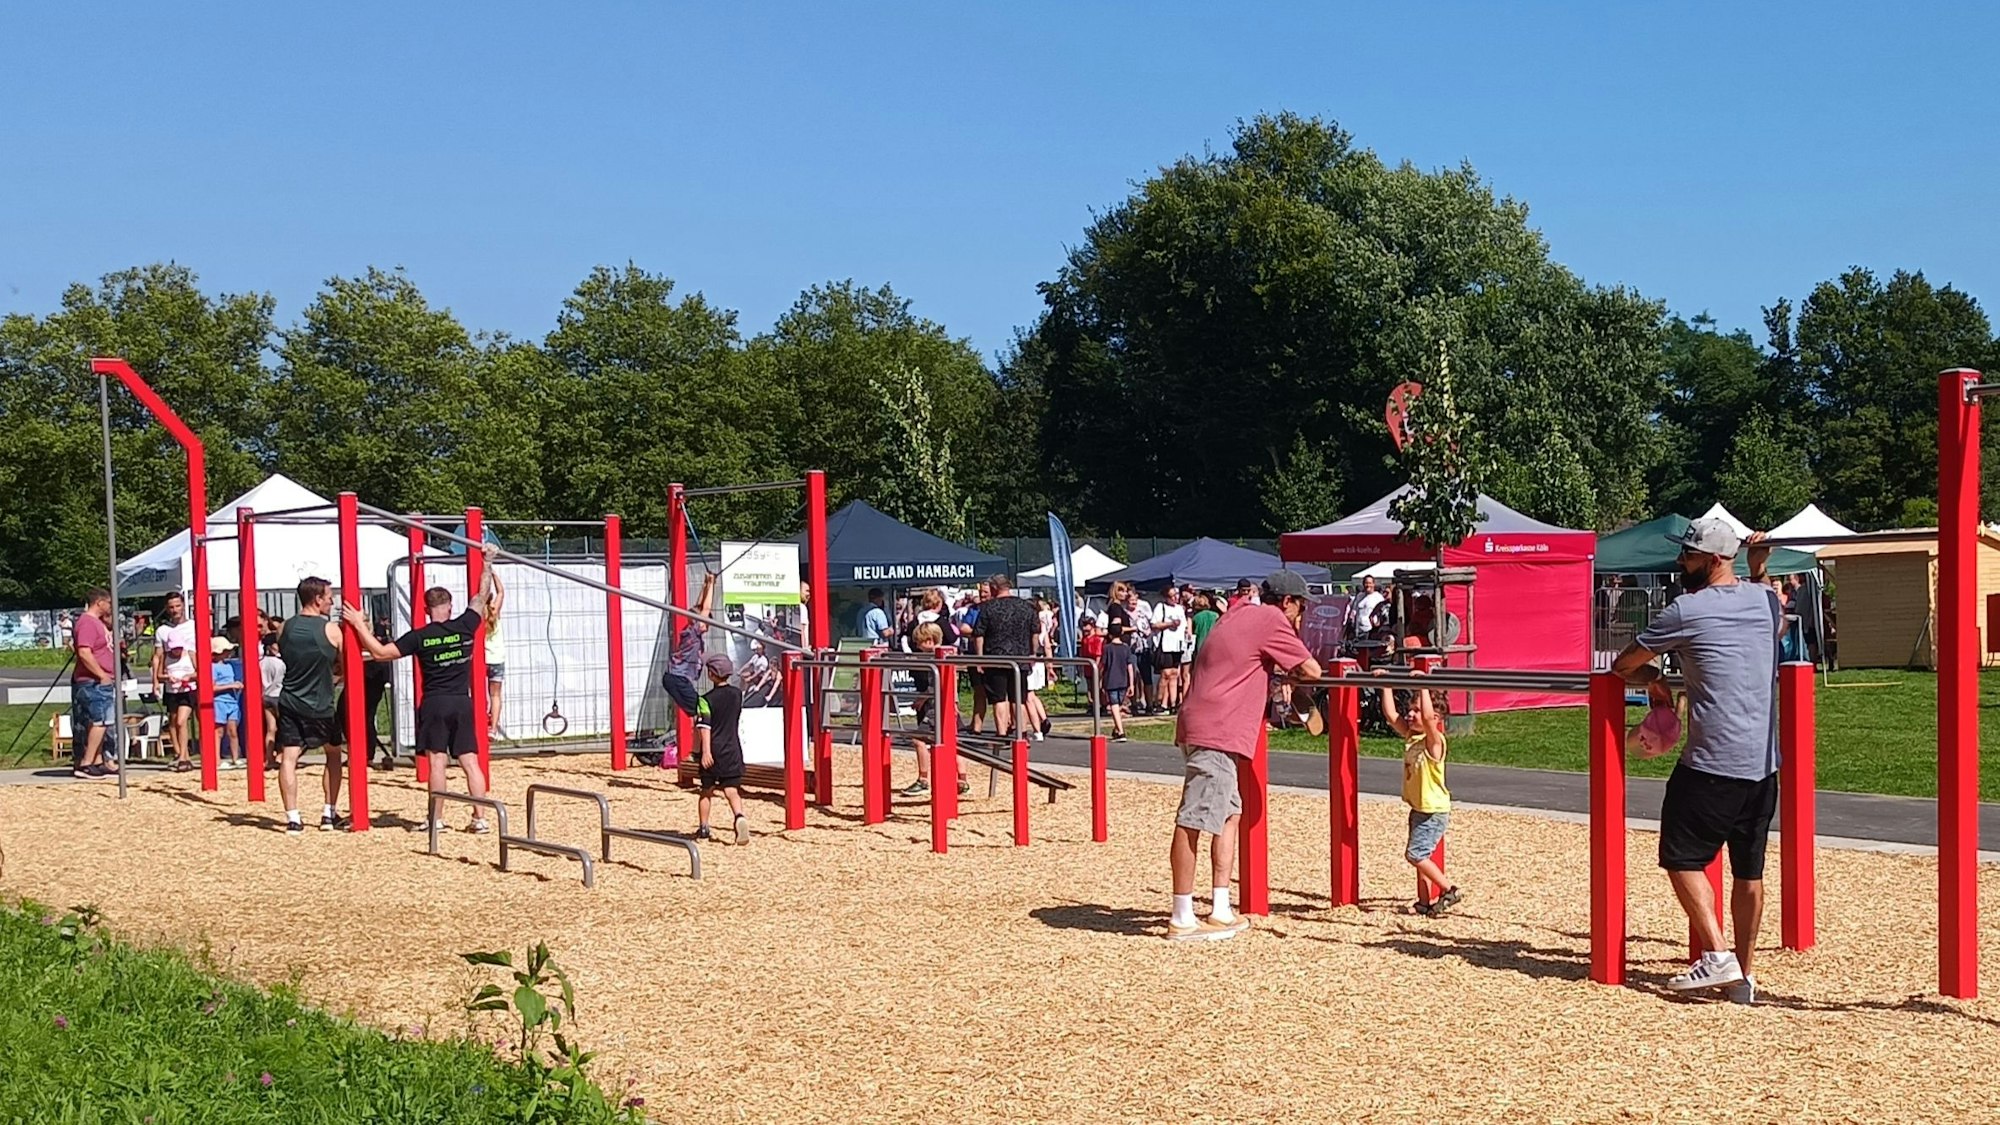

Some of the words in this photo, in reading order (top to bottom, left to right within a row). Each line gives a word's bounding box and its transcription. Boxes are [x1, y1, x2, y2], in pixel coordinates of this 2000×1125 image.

[854, 566, 914, 580] NEULAND
[916, 565, 975, 578] HAMBACH
[434, 650, 462, 662] Leben
